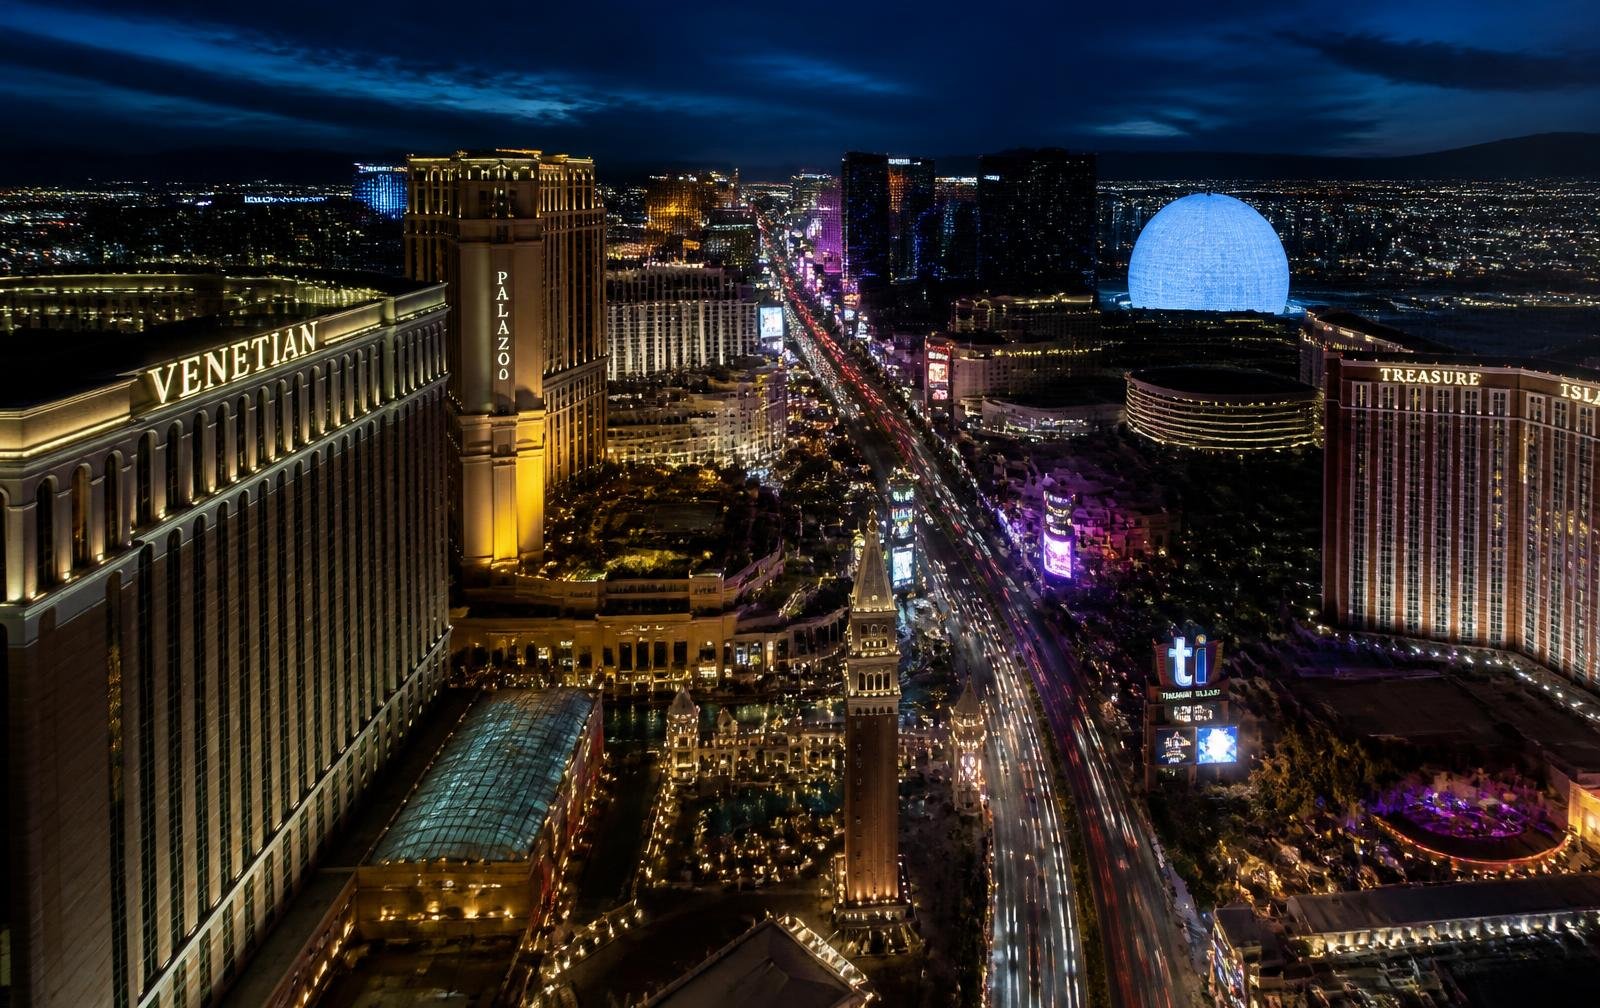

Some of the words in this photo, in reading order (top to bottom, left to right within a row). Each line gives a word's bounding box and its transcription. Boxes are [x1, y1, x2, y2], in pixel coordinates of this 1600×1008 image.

[147, 321, 318, 404] VENETIAN
[1380, 368, 1482, 386] TREASURE
[1168, 634, 1207, 687] ti
